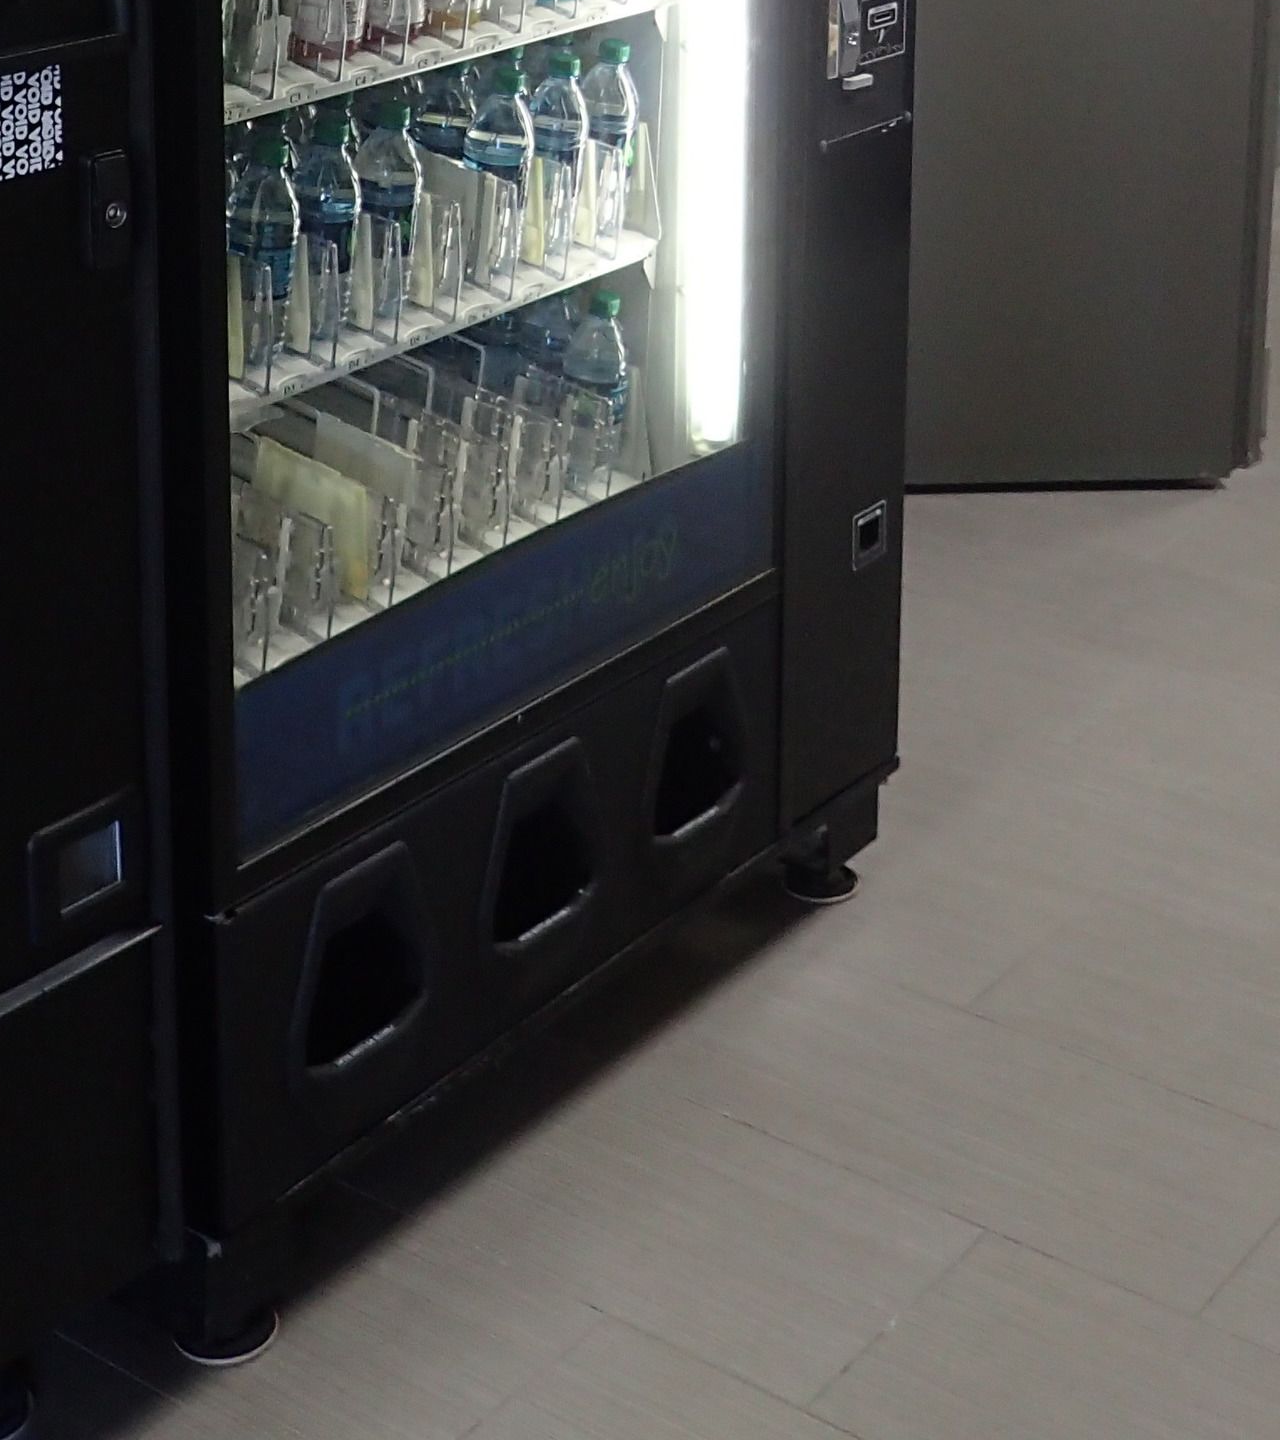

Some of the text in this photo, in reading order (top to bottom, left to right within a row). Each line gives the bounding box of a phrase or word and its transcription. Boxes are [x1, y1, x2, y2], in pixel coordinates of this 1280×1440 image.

[14, 88, 28, 140] VOID
[28, 73, 42, 124] VOID
[1, 105, 15, 156] VOID
